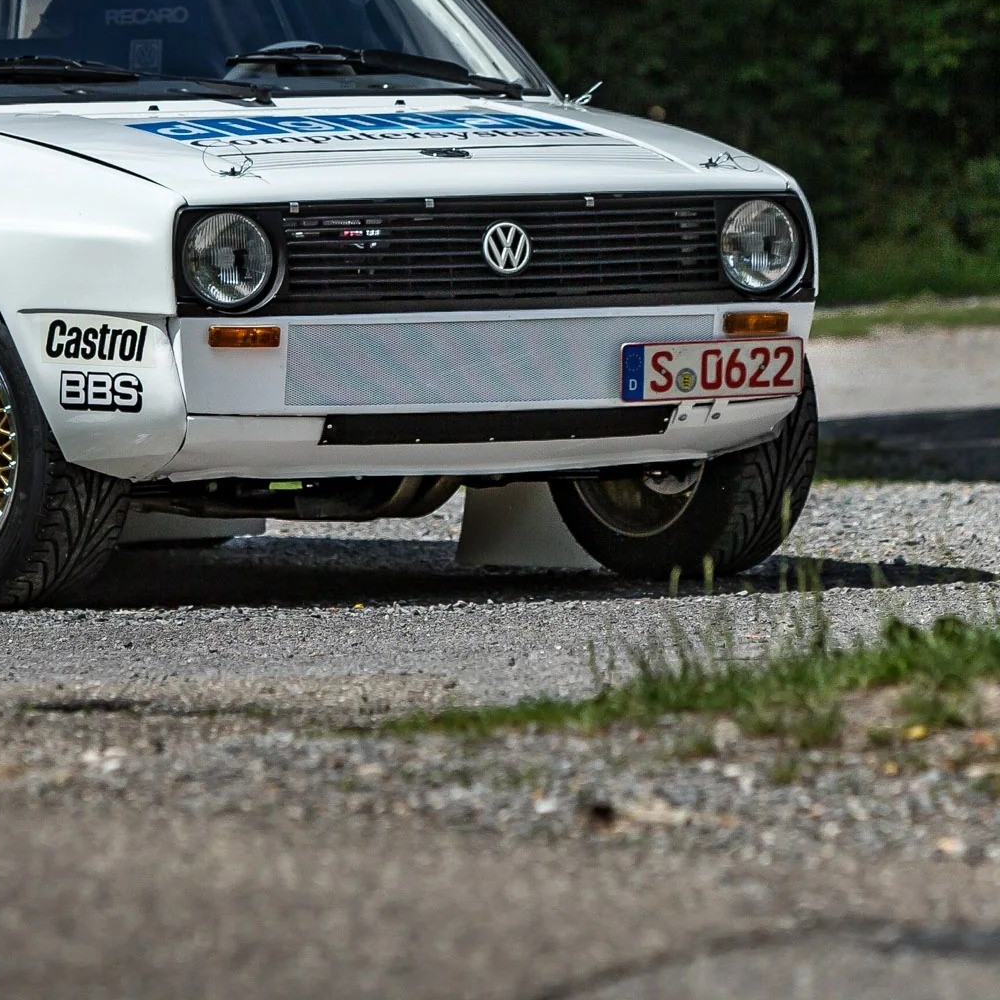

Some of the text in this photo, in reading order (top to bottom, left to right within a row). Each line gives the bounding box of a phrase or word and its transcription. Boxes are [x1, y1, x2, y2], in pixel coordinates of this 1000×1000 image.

[105, 6, 189, 25] RECARO
[156, 116, 552, 137] digital
[190, 130, 607, 147] Computersysteme
[46, 319, 148, 362] Castrol
[650, 345, 794, 393] S 0622
[60, 370, 143, 413] BBS
[628, 379, 638, 391] D
